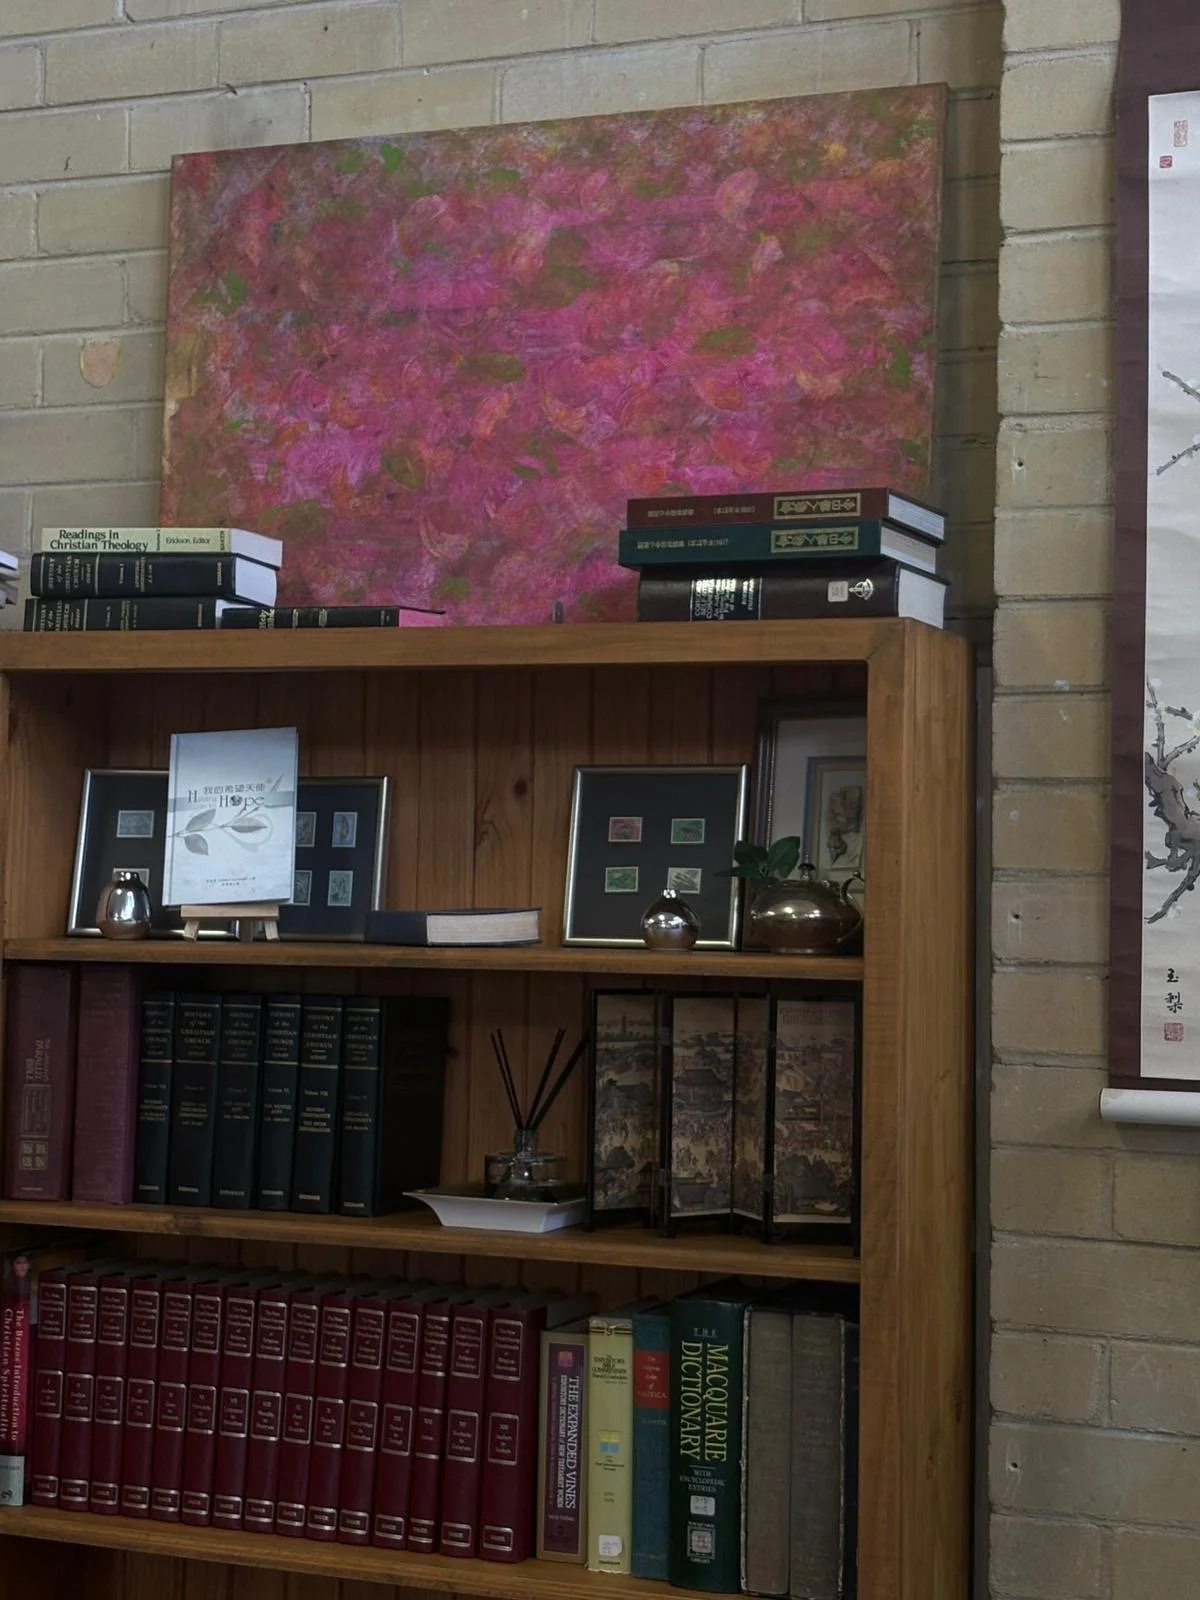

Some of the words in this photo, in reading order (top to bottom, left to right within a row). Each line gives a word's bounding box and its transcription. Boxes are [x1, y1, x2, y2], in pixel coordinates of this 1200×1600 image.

[50, 540, 98, 550] Christian
[101, 540, 148, 552] Theology
[59, 530, 107, 541] Readings
[108, 530, 119, 540] in
[3, 1308, 13, 1365] Christian
[693, 1328, 718, 1338] THE
[12, 1364, 22, 1428] Introduction
[568, 1376, 579, 1402] THE
[680, 1340, 702, 1461] DICTIONARY
[702, 1342, 728, 1462] MACQUARIE
[11, 1430, 19, 1441] to
[566, 1404, 578, 1468] EXPANDED
